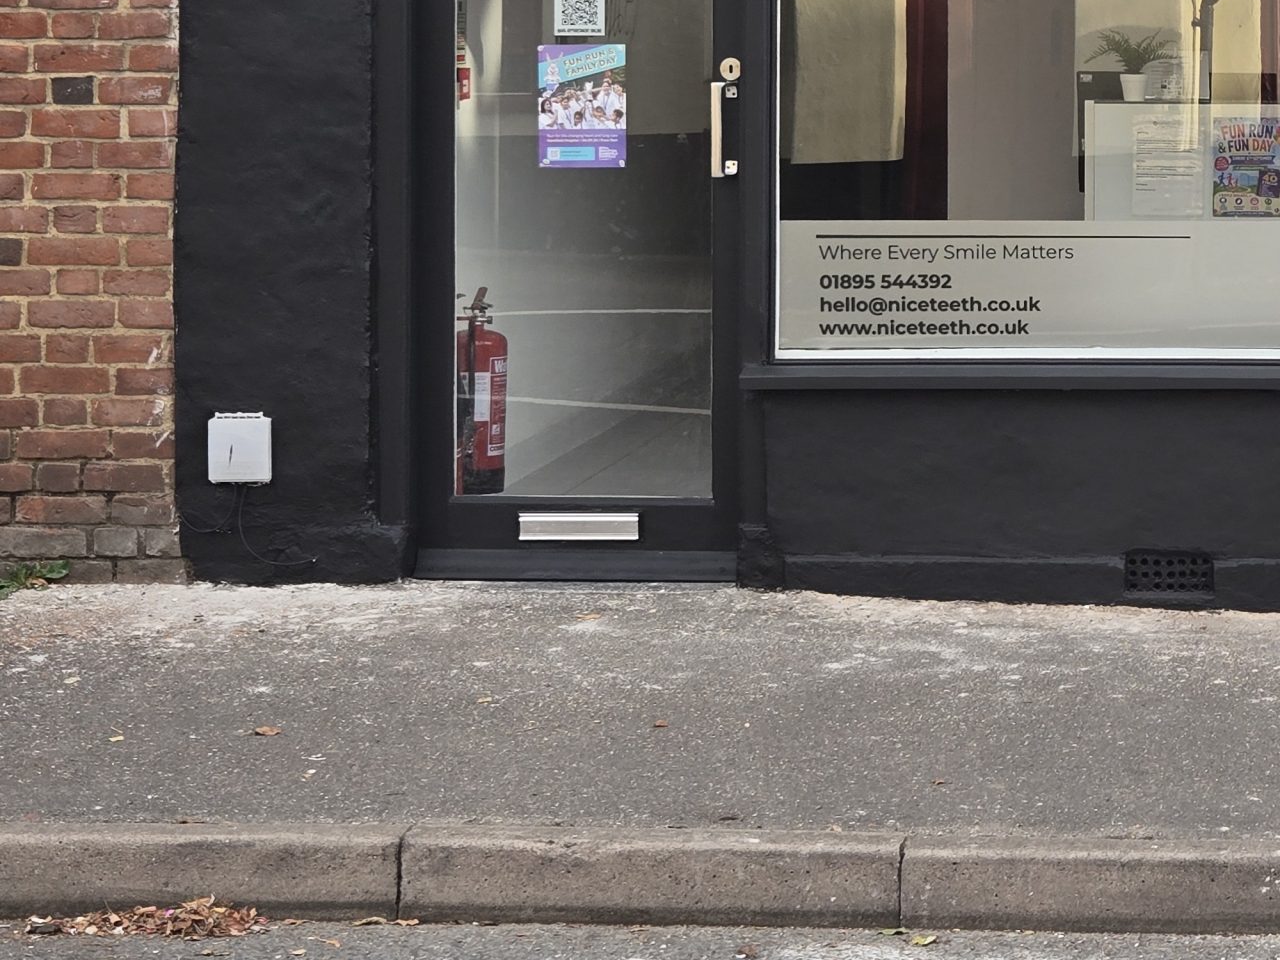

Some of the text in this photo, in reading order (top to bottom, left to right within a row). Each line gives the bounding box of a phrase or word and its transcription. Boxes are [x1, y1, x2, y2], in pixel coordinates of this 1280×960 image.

[562, 56, 582, 66] FUN
[584, 50, 606, 60] RUN
[566, 55, 618, 76] FAMILY DAY
[1221, 124, 1274, 140] FUN RUN
[1218, 140, 1274, 153] & FUN DAY
[819, 244, 1074, 263] Where Every Smile Matters
[819, 274, 952, 290] 01895 544392
[820, 296, 1041, 316] hello@niceteeth.co.uk
[819, 320, 1030, 336] www.niceteeth.co.uk
